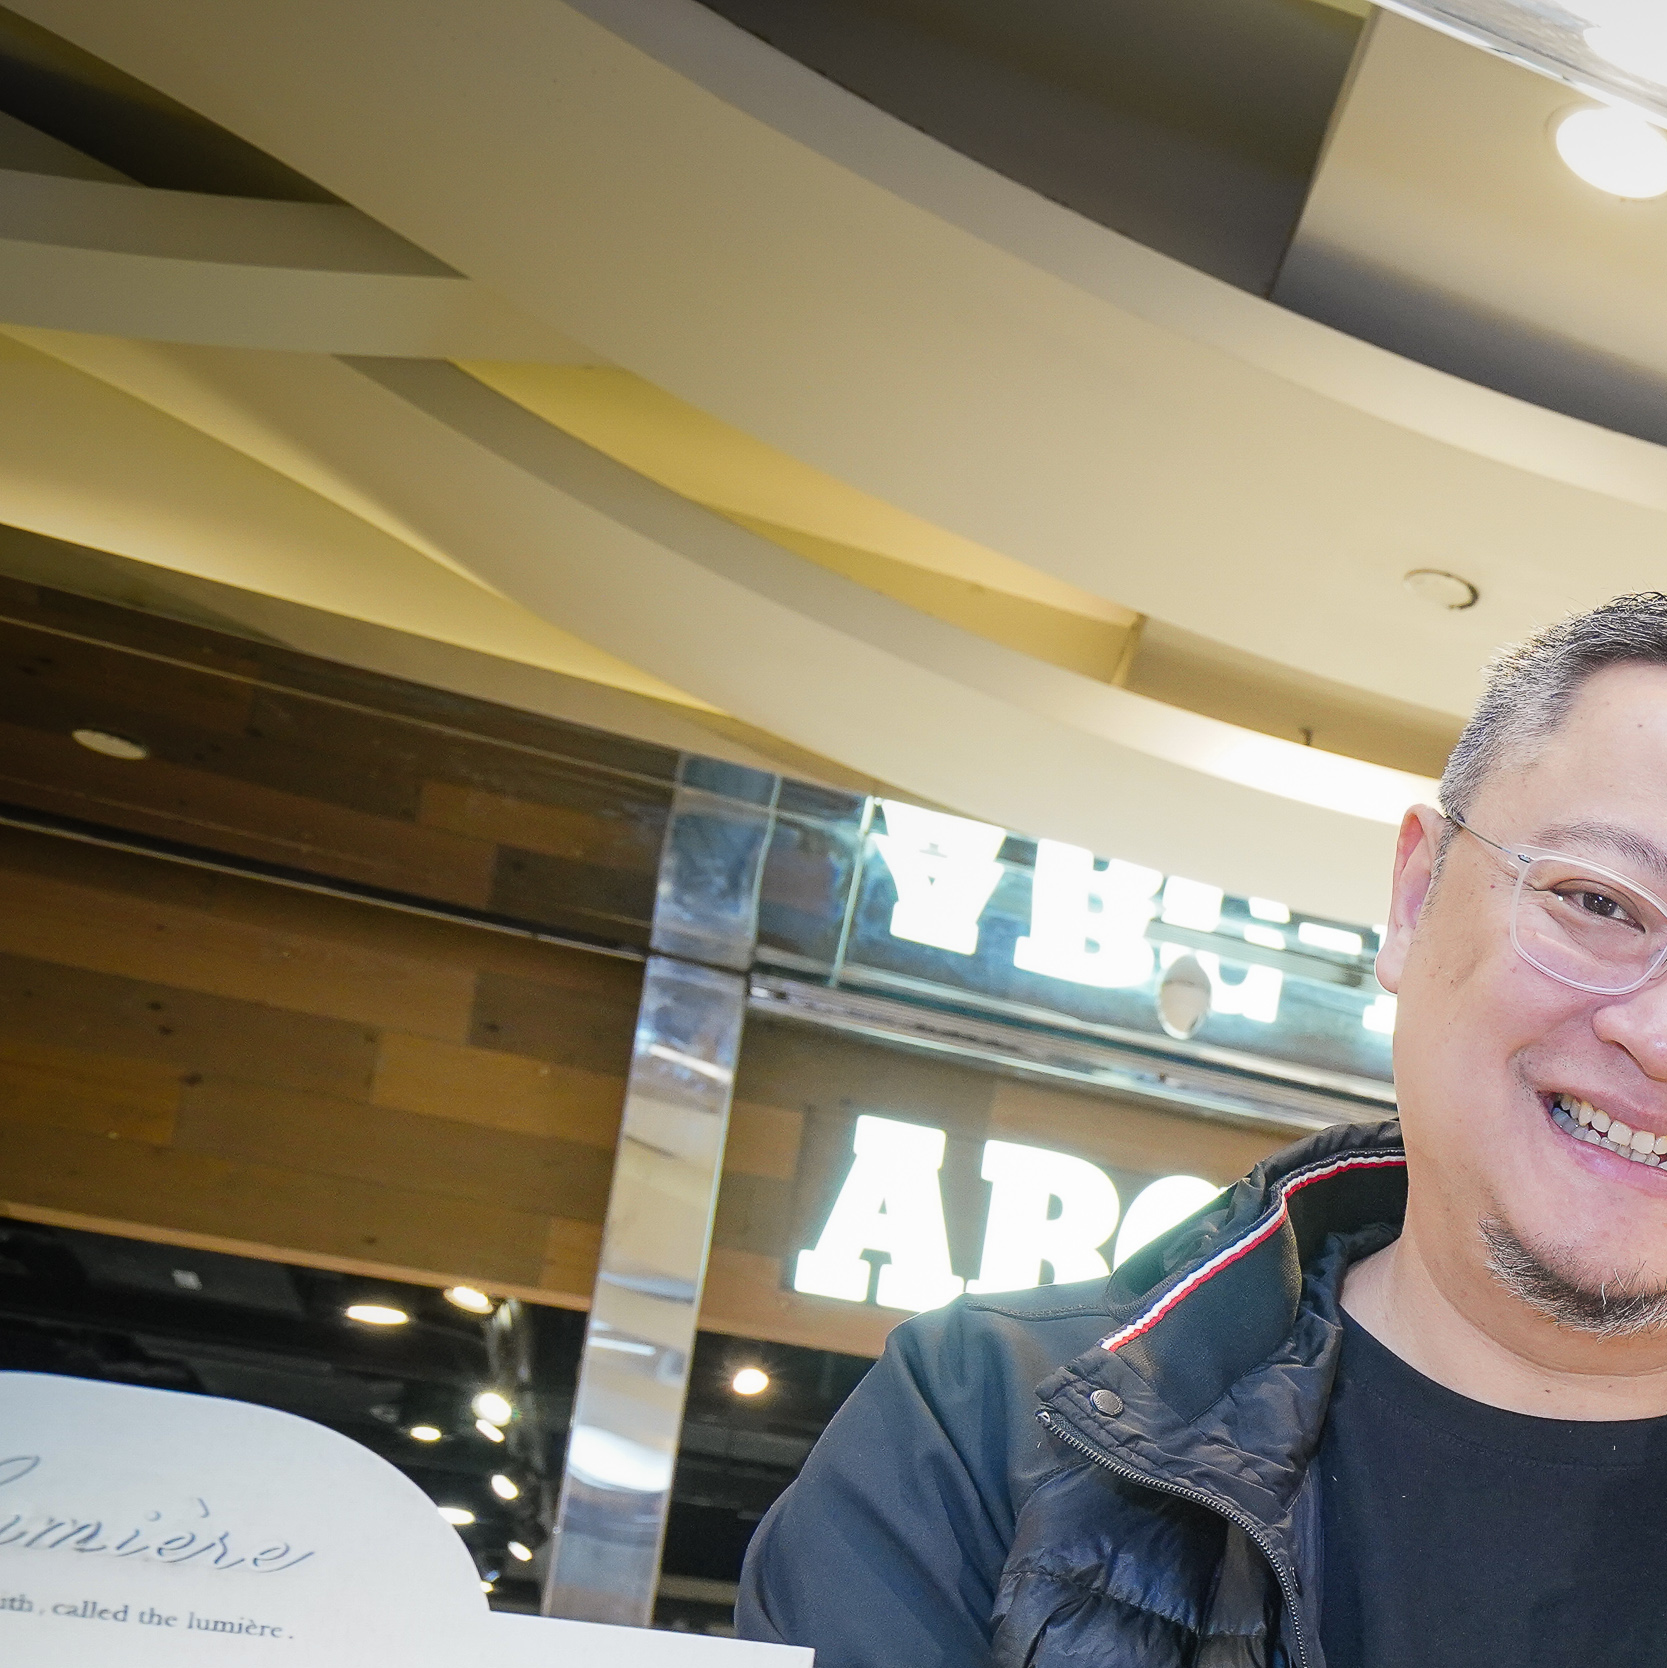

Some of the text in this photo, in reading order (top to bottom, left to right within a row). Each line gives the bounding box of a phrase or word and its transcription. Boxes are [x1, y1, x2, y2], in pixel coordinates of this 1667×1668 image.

[52, 1600, 129, 1622] called
[139, 1607, 178, 1628] the
[187, 1612, 294, 1640] lumière.
